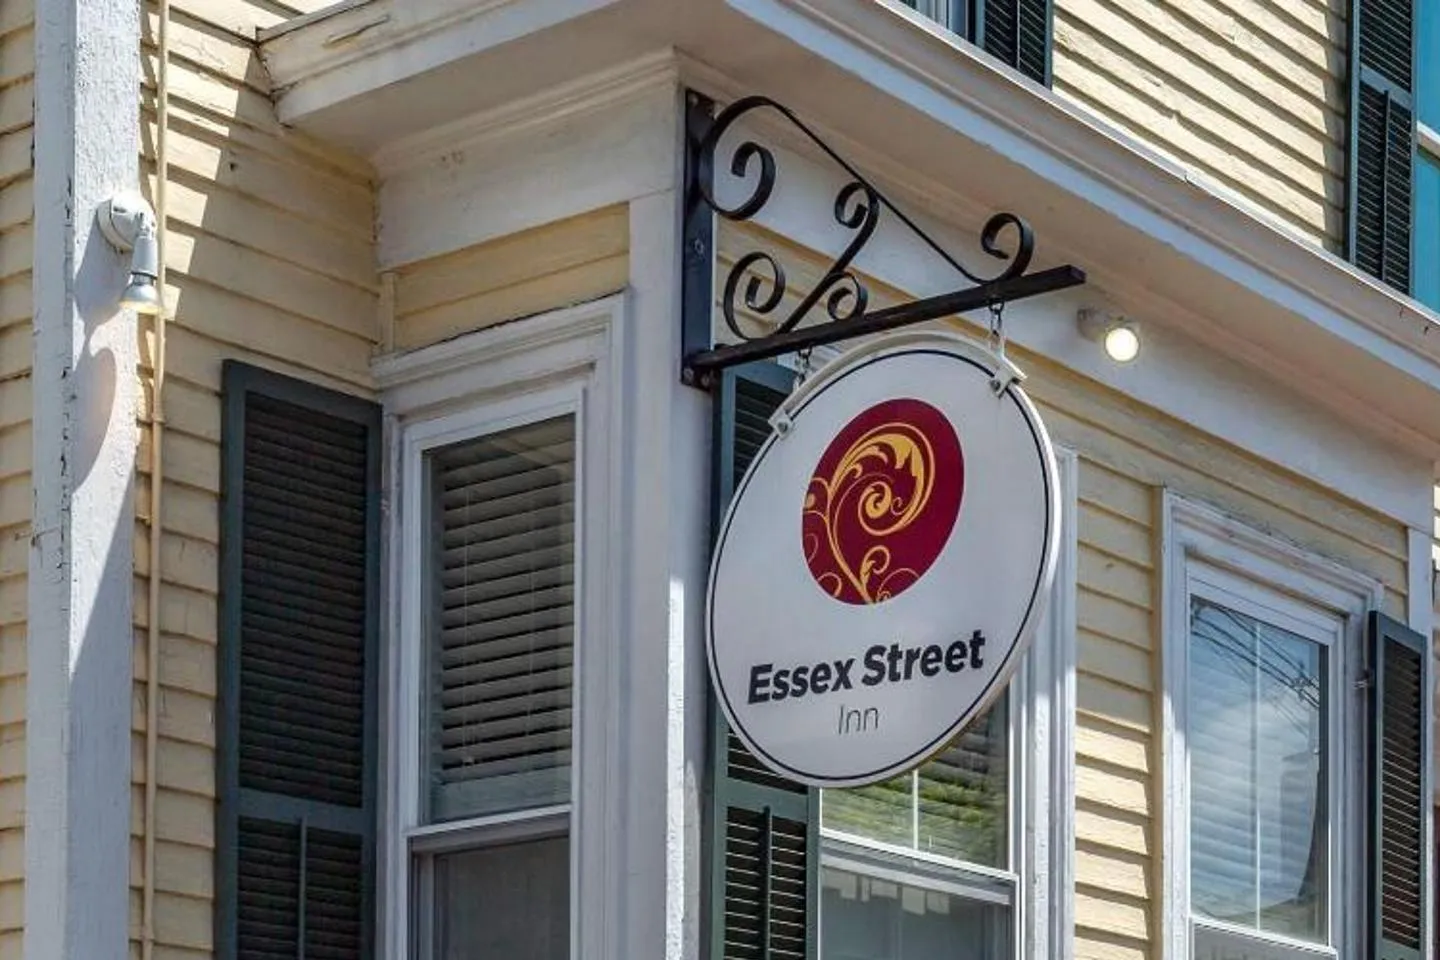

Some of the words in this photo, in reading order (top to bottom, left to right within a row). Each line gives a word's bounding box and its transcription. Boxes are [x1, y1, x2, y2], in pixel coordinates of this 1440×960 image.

[748, 658, 856, 704] Essex
[861, 630, 986, 686] Street
[837, 704, 880, 734] Inn
